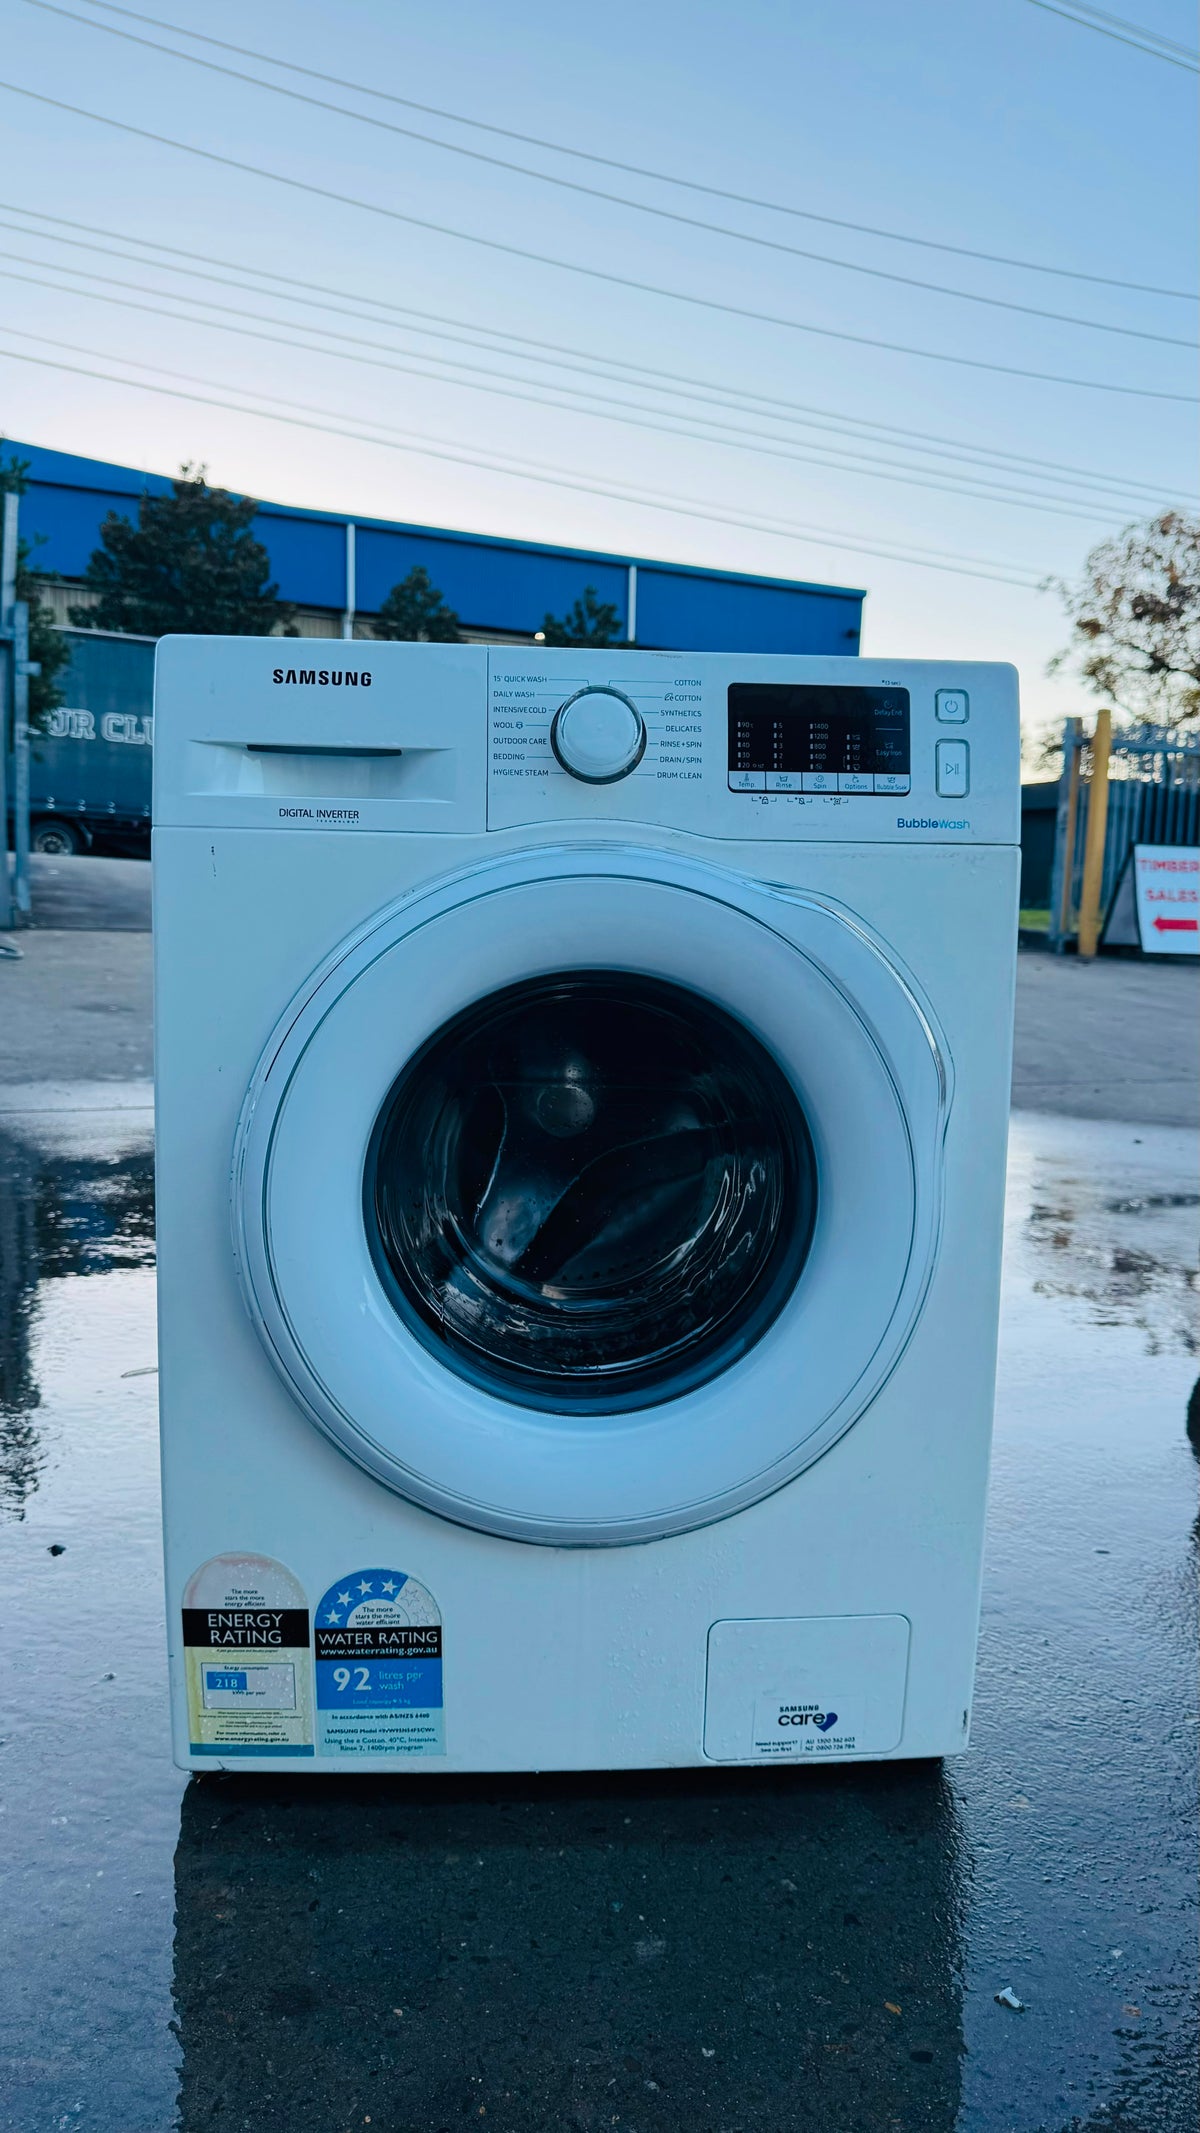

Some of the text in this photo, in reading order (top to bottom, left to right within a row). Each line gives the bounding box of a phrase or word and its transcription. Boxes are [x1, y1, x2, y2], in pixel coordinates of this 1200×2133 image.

[272, 669, 372, 687] SAMSUNG
[504, 675, 526, 683] QUICK
[660, 709, 702, 717] SYNTHETICS
[493, 721, 514, 729] WOOL
[660, 740, 680, 748] RINSE
[844, 783, 868, 791] Options
[279, 808, 359, 819] DIGITAL INVERTER
[897, 818, 971, 829] BubbleWash
[1139, 859, 1200, 872] TIMBER
[1146, 889, 1198, 902] SALES
[207, 1613, 283, 1628] ENERGY
[210, 1629, 282, 1644] RATING
[318, 1631, 438, 1645] WATER RATING
[320, 1646, 438, 1656] www.waterrating.gov.au
[215, 1678, 238, 1688] 218
[333, 1667, 372, 1691] 92
[378, 1671, 404, 1680] litres
[379, 1681, 404, 1690] wash
[778, 1713, 825, 1726] care
